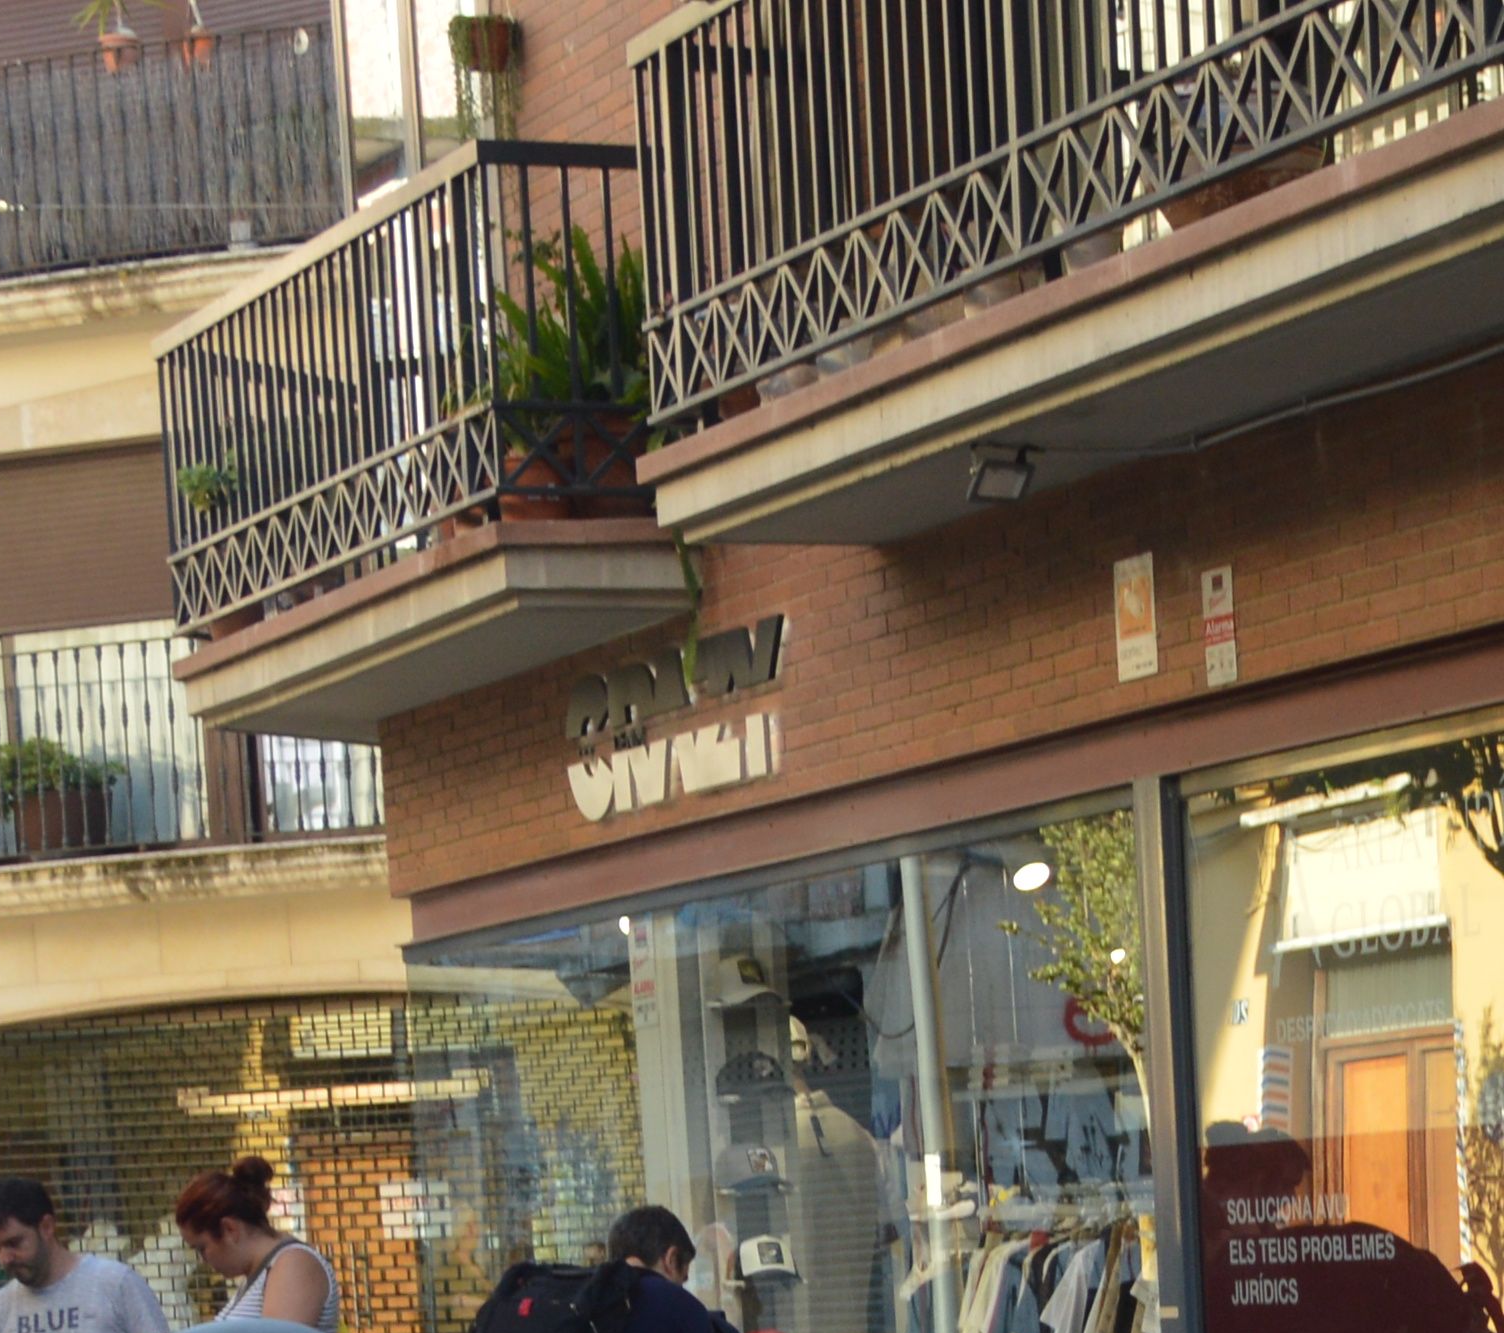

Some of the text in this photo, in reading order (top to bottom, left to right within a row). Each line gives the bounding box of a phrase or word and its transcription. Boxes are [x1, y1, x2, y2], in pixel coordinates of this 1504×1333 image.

[1330, 883, 1480, 959] GLOBAL
[1227, 1195, 1313, 1225] SOLUCIONA
[1229, 1232, 1396, 1266] ELS TEUS PROBLEMES
[1231, 1272, 1299, 1306] JURÍDICS
